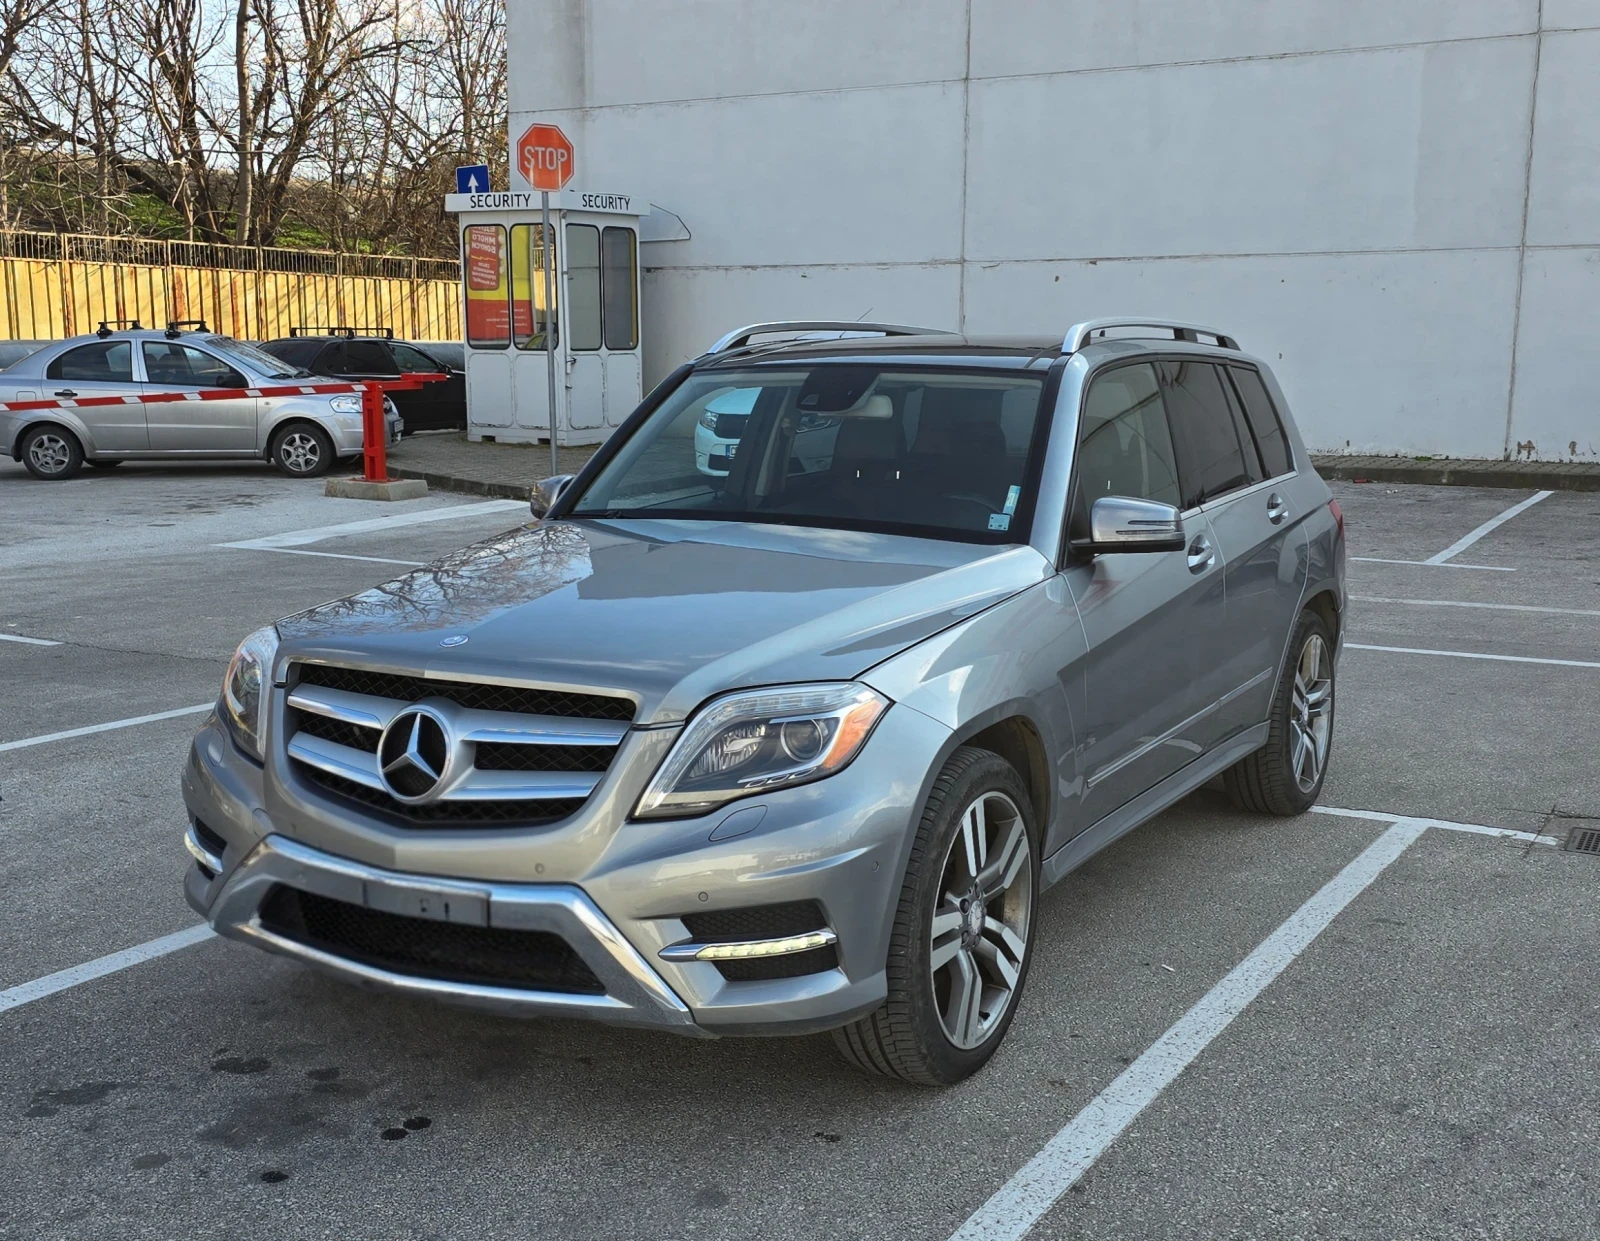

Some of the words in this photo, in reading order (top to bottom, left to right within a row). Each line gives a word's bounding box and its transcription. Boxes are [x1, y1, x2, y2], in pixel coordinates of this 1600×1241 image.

[524, 146, 568, 171] STOP
[470, 194, 531, 208] SECURITY
[581, 194, 631, 210] SECURITY
